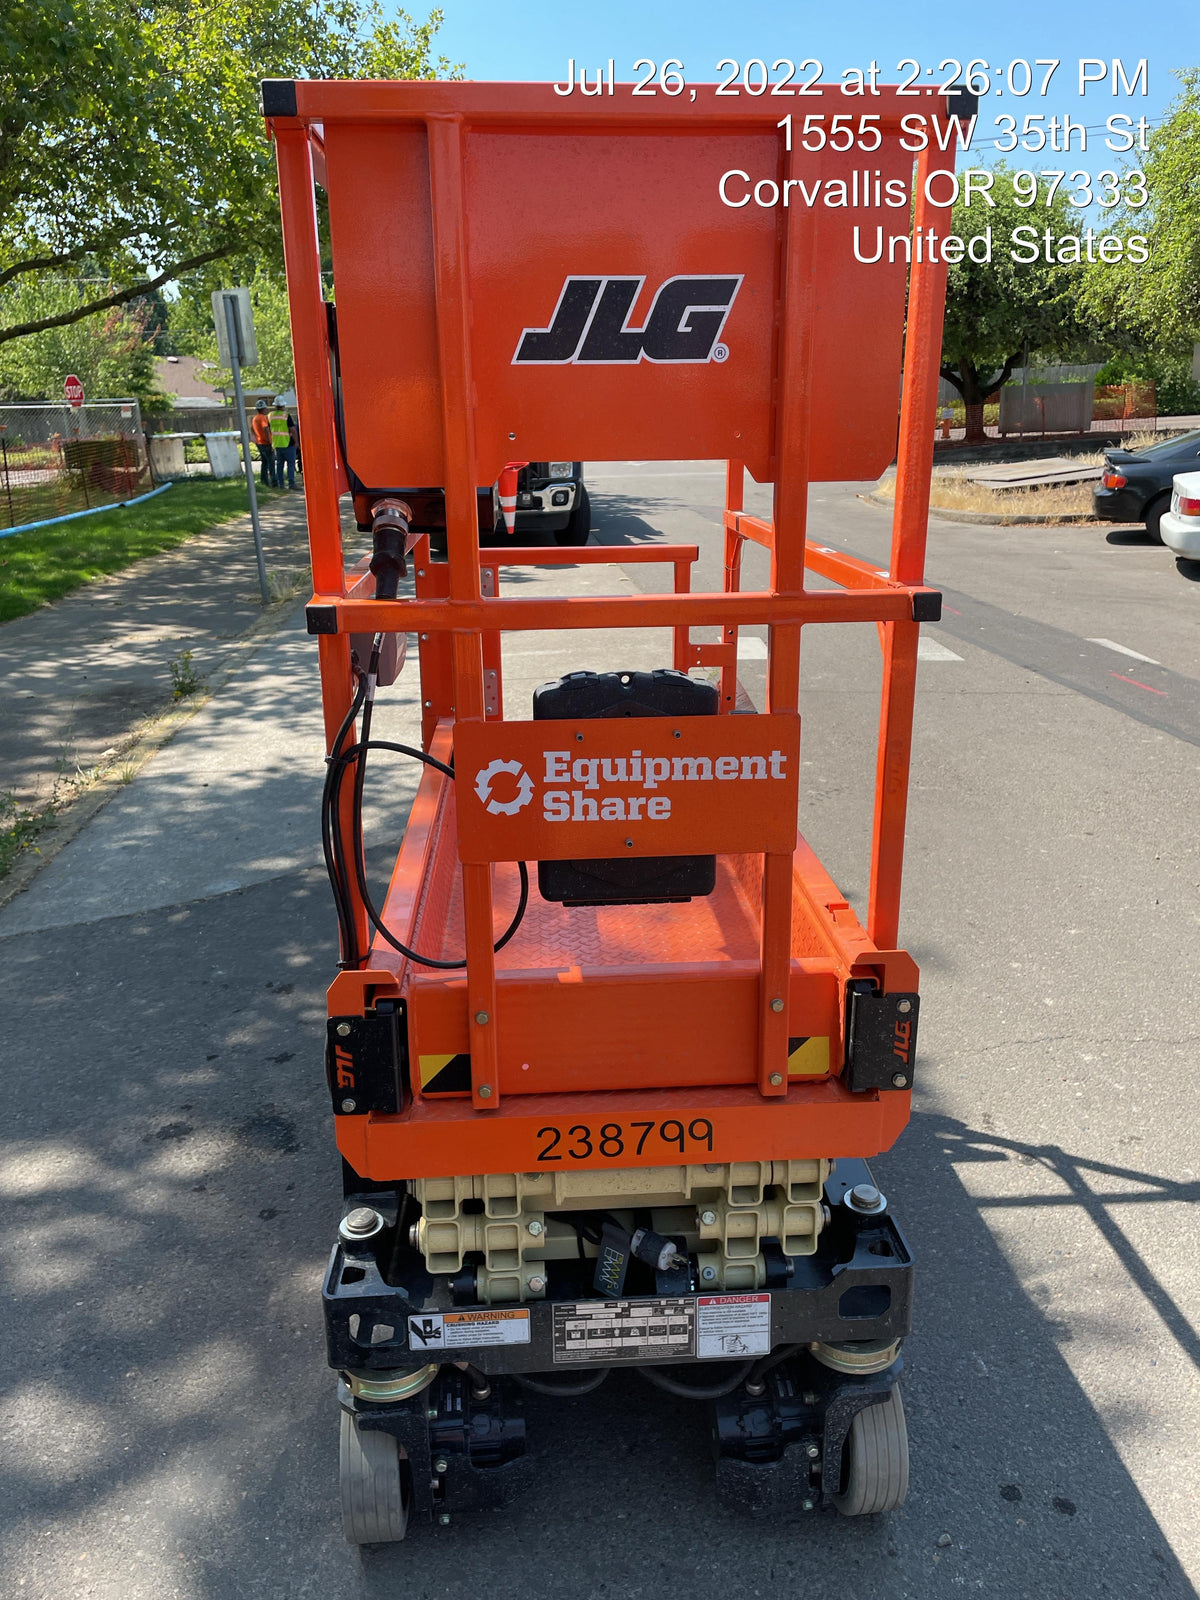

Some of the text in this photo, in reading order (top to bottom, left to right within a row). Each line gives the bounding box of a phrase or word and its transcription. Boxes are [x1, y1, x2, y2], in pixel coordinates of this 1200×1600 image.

[65, 385, 81, 398] STOP
[542, 750, 787, 789] Equipment
[543, 790, 672, 822] Share
[893, 1020, 911, 1064] JLG
[335, 1045, 355, 1089] JLG
[537, 1118, 713, 1161] 238799
[467, 1311, 515, 1321] WARNING
[720, 1295, 759, 1305] DANGER
